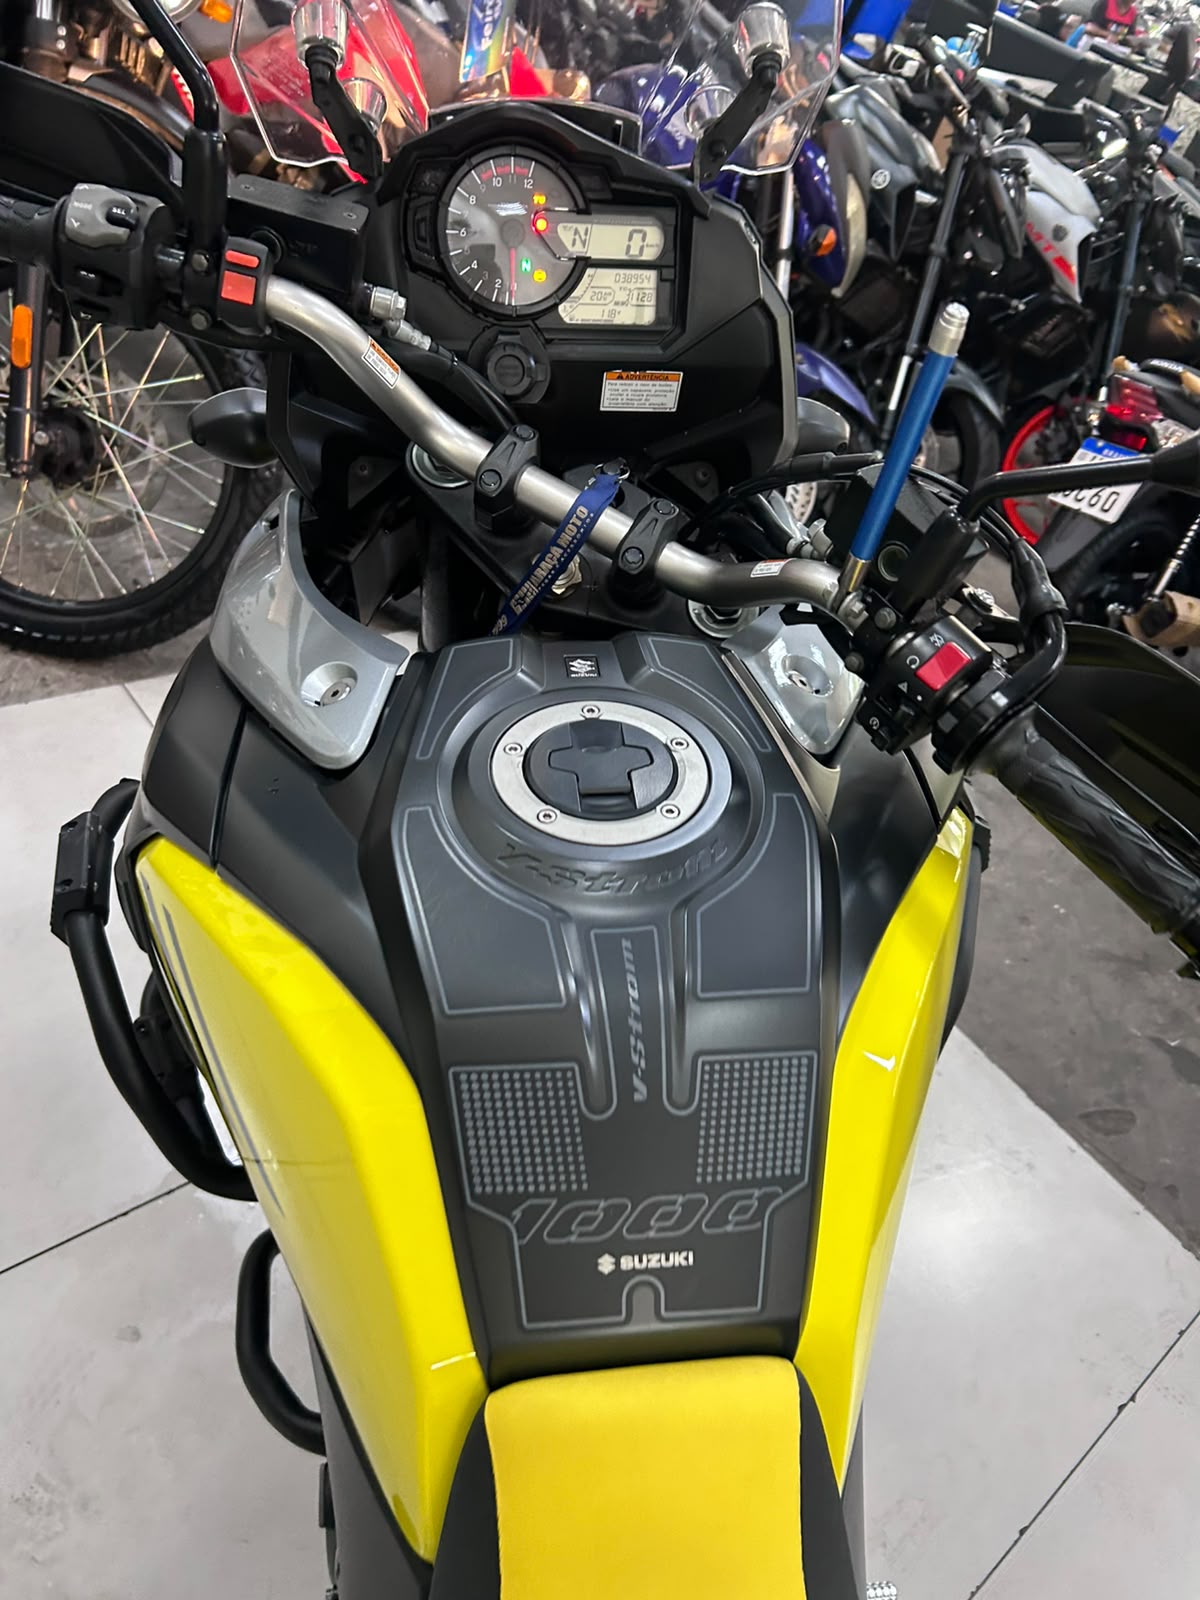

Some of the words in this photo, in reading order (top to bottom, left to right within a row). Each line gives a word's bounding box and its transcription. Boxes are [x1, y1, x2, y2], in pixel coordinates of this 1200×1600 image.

[492, 177, 502, 187] 10
[524, 179, 533, 189] 12
[469, 195, 477, 205] 8
[459, 228, 467, 237] 6
[571, 226, 589, 249] N
[626, 229, 647, 257] 0
[471, 260, 478, 269] 4
[495, 279, 502, 288] 2
[614, 273, 652, 284] 038954
[556, 505, 589, 547] MOTO
[621, 937, 648, 1103] V-Strom
[512, 1186, 783, 1245] 1000
[620, 1250, 694, 1271] SUZUKI
